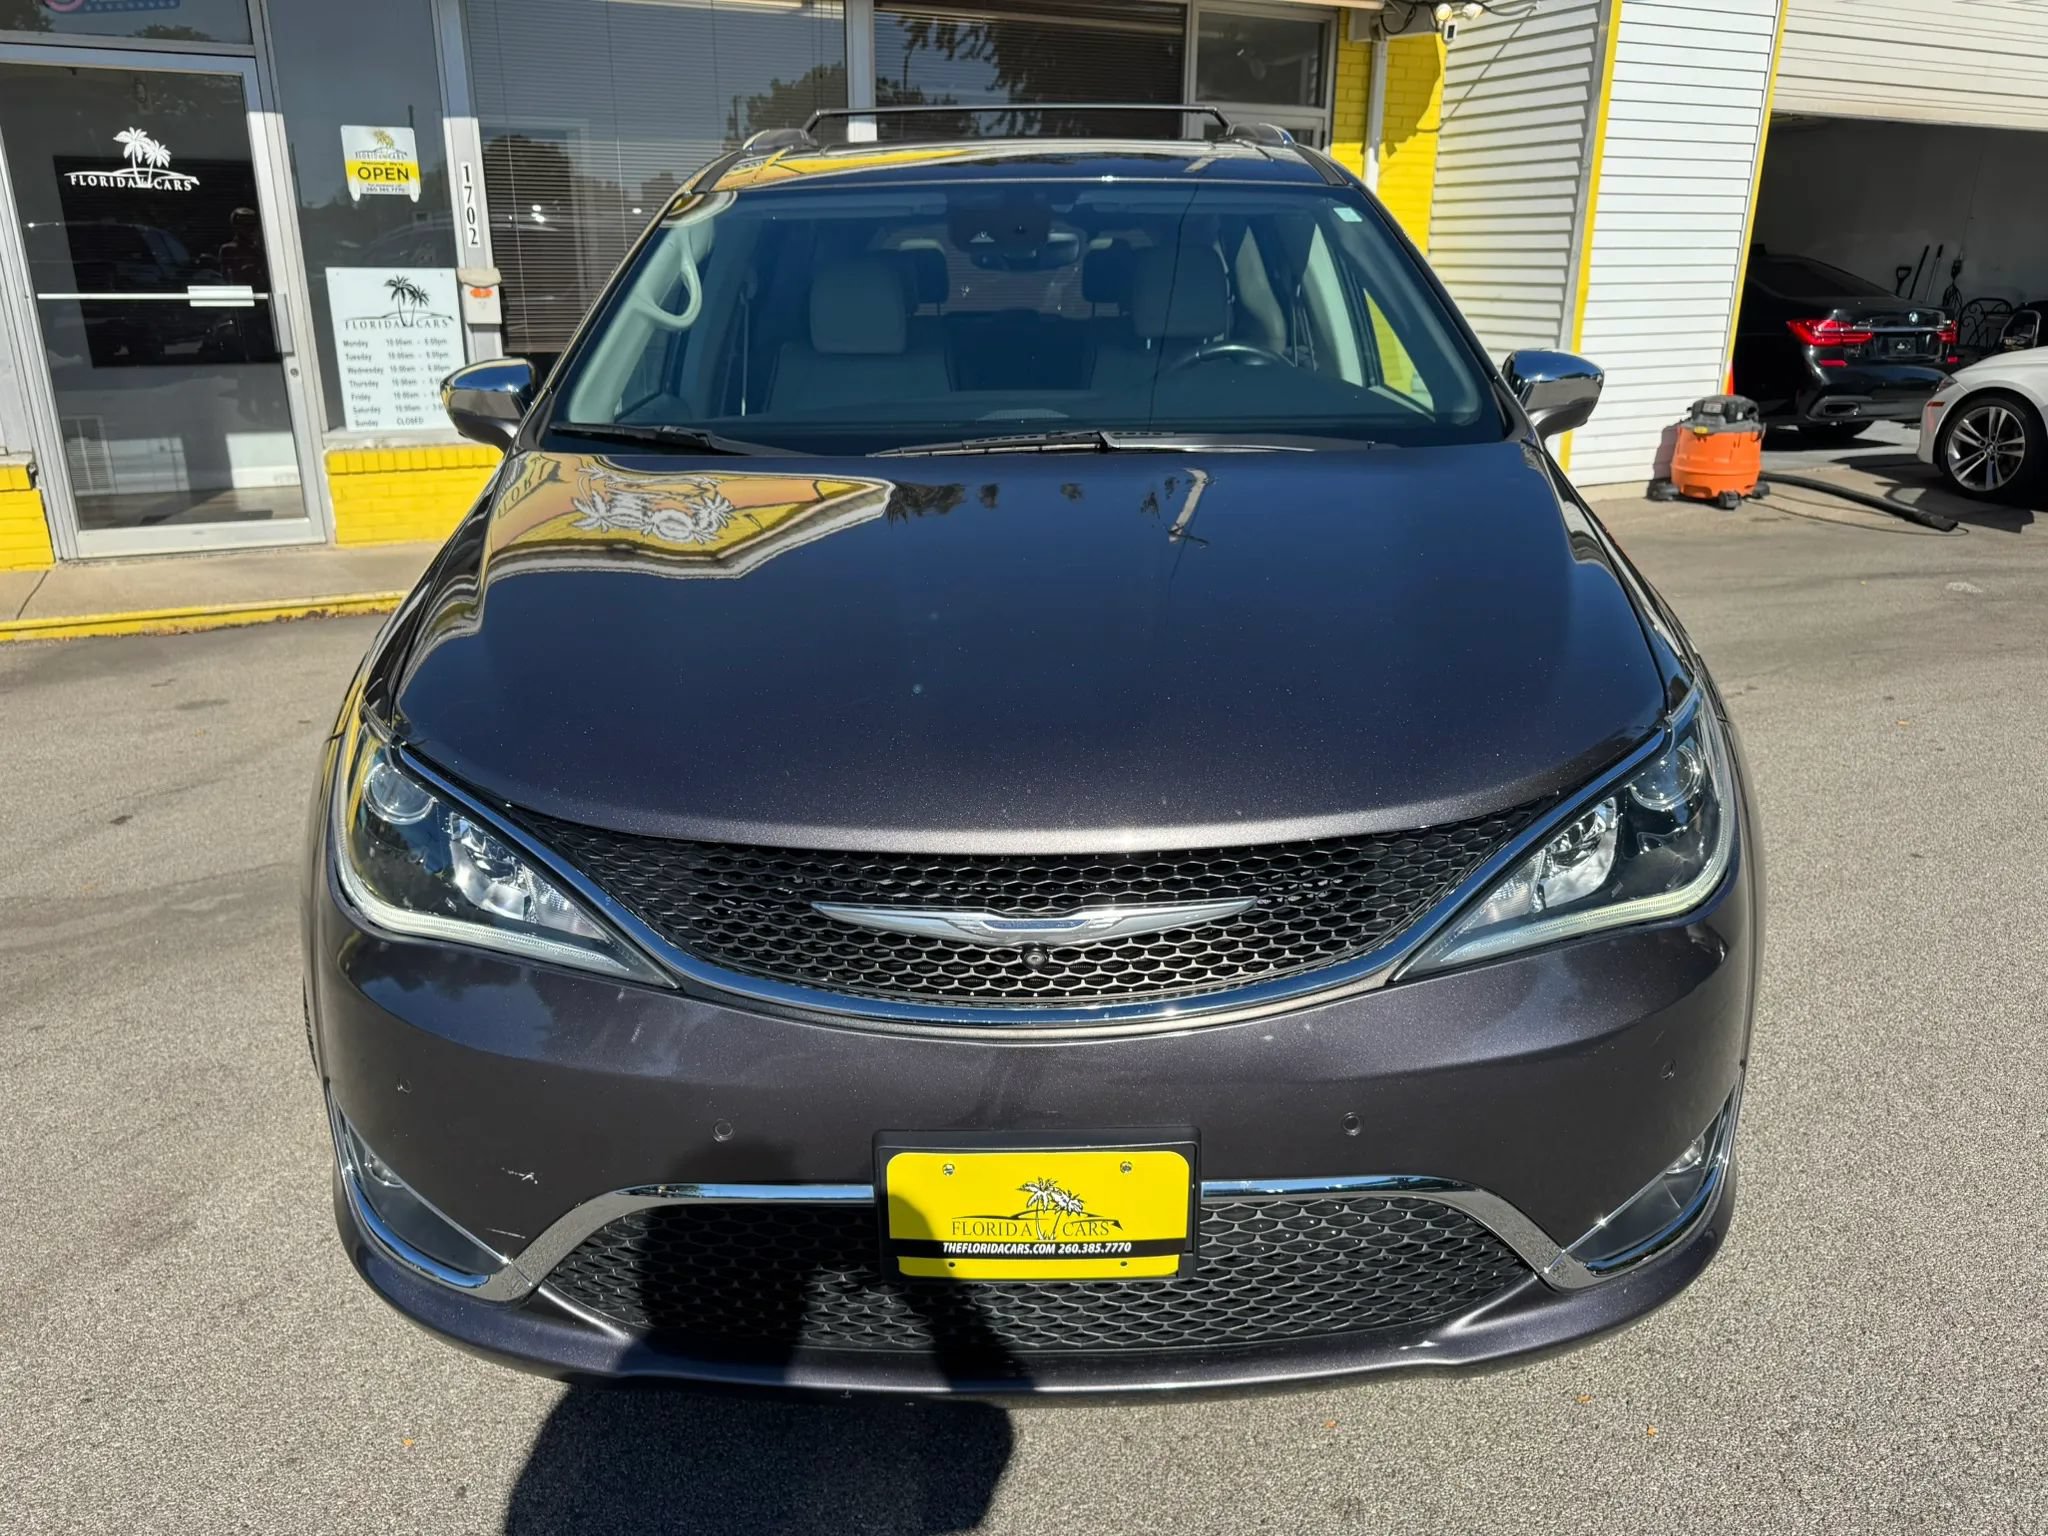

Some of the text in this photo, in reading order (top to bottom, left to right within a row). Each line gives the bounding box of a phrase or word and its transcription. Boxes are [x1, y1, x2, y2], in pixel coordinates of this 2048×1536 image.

[357, 166, 409, 181] OPEN
[70, 174, 192, 191] FLORIDA CARS
[463, 164, 479, 246] 1702
[345, 319, 449, 330] FLORIDA CARS
[343, 340, 368, 348] Monday
[345, 353, 372, 361] Tuesday
[347, 367, 384, 375] Wednesday
[349, 380, 379, 389] Thursday
[351, 393, 371, 402] Friday
[353, 406, 381, 415] Saturday
[355, 417, 424, 427] Sunday CLOSED
[951, 1220, 1110, 1237] FLORIDA CARS
[943, 1241, 1132, 1256] THEFLORIDACARS.COM 260.385.7770
